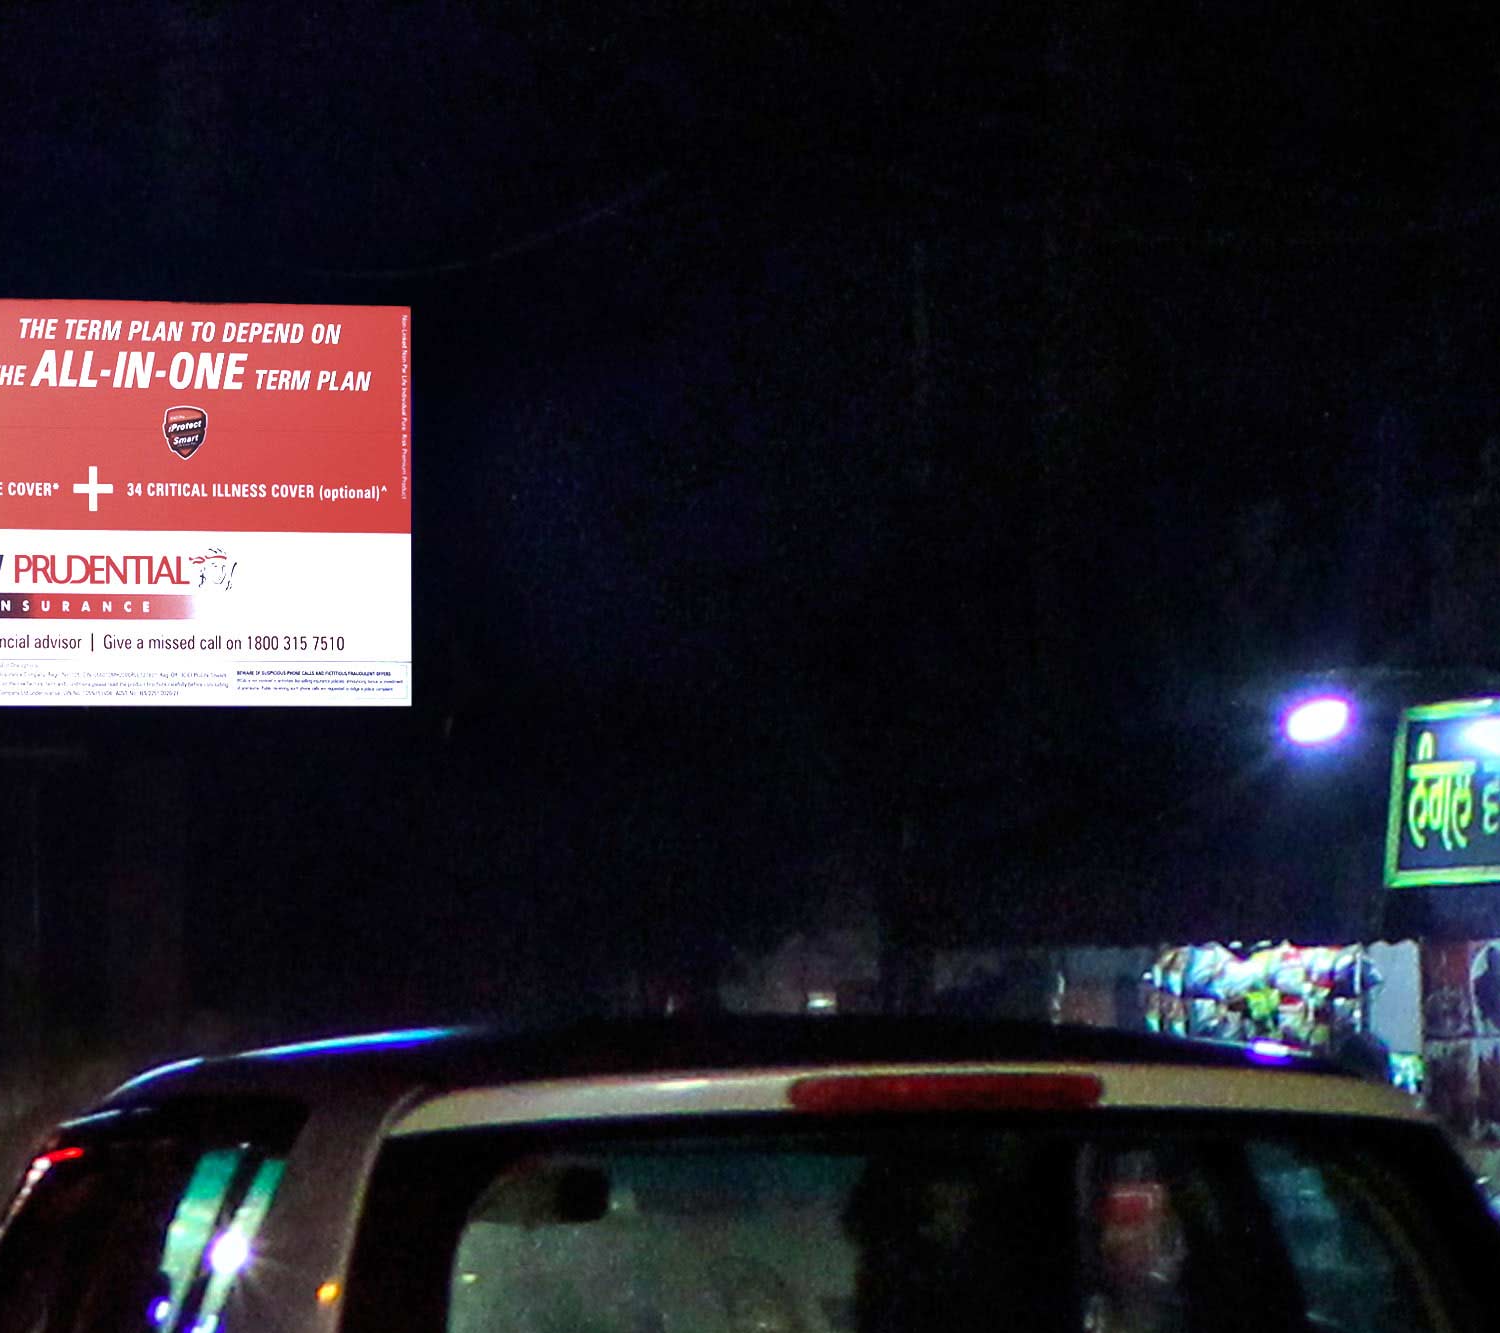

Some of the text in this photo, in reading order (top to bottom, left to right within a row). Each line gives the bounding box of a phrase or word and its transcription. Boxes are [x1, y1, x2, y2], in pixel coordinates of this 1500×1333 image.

[18, 318, 342, 345] THE TERM PLAN TO DEPEND ON
[29, 349, 249, 391] ALL-IN-ONE
[255, 370, 311, 391] TERM
[316, 371, 372, 392] PLAN
[173, 434, 199, 446] Smart
[126, 483, 142, 498] 34
[146, 484, 209, 499] CRITICAL
[212, 485, 267, 500] ILLNESS
[271, 485, 315, 500] COVER
[14, 554, 191, 585] PRUDENTIAL
[34, 633, 82, 650] advisor
[103, 634, 133, 650] Give
[136, 639, 144, 651] a
[148, 634, 195, 651] missed
[200, 634, 222, 651] call
[226, 640, 242, 651] on
[247, 635, 280, 651] 1800
[283, 635, 308, 651] 315
[312, 636, 345, 652] 7510
